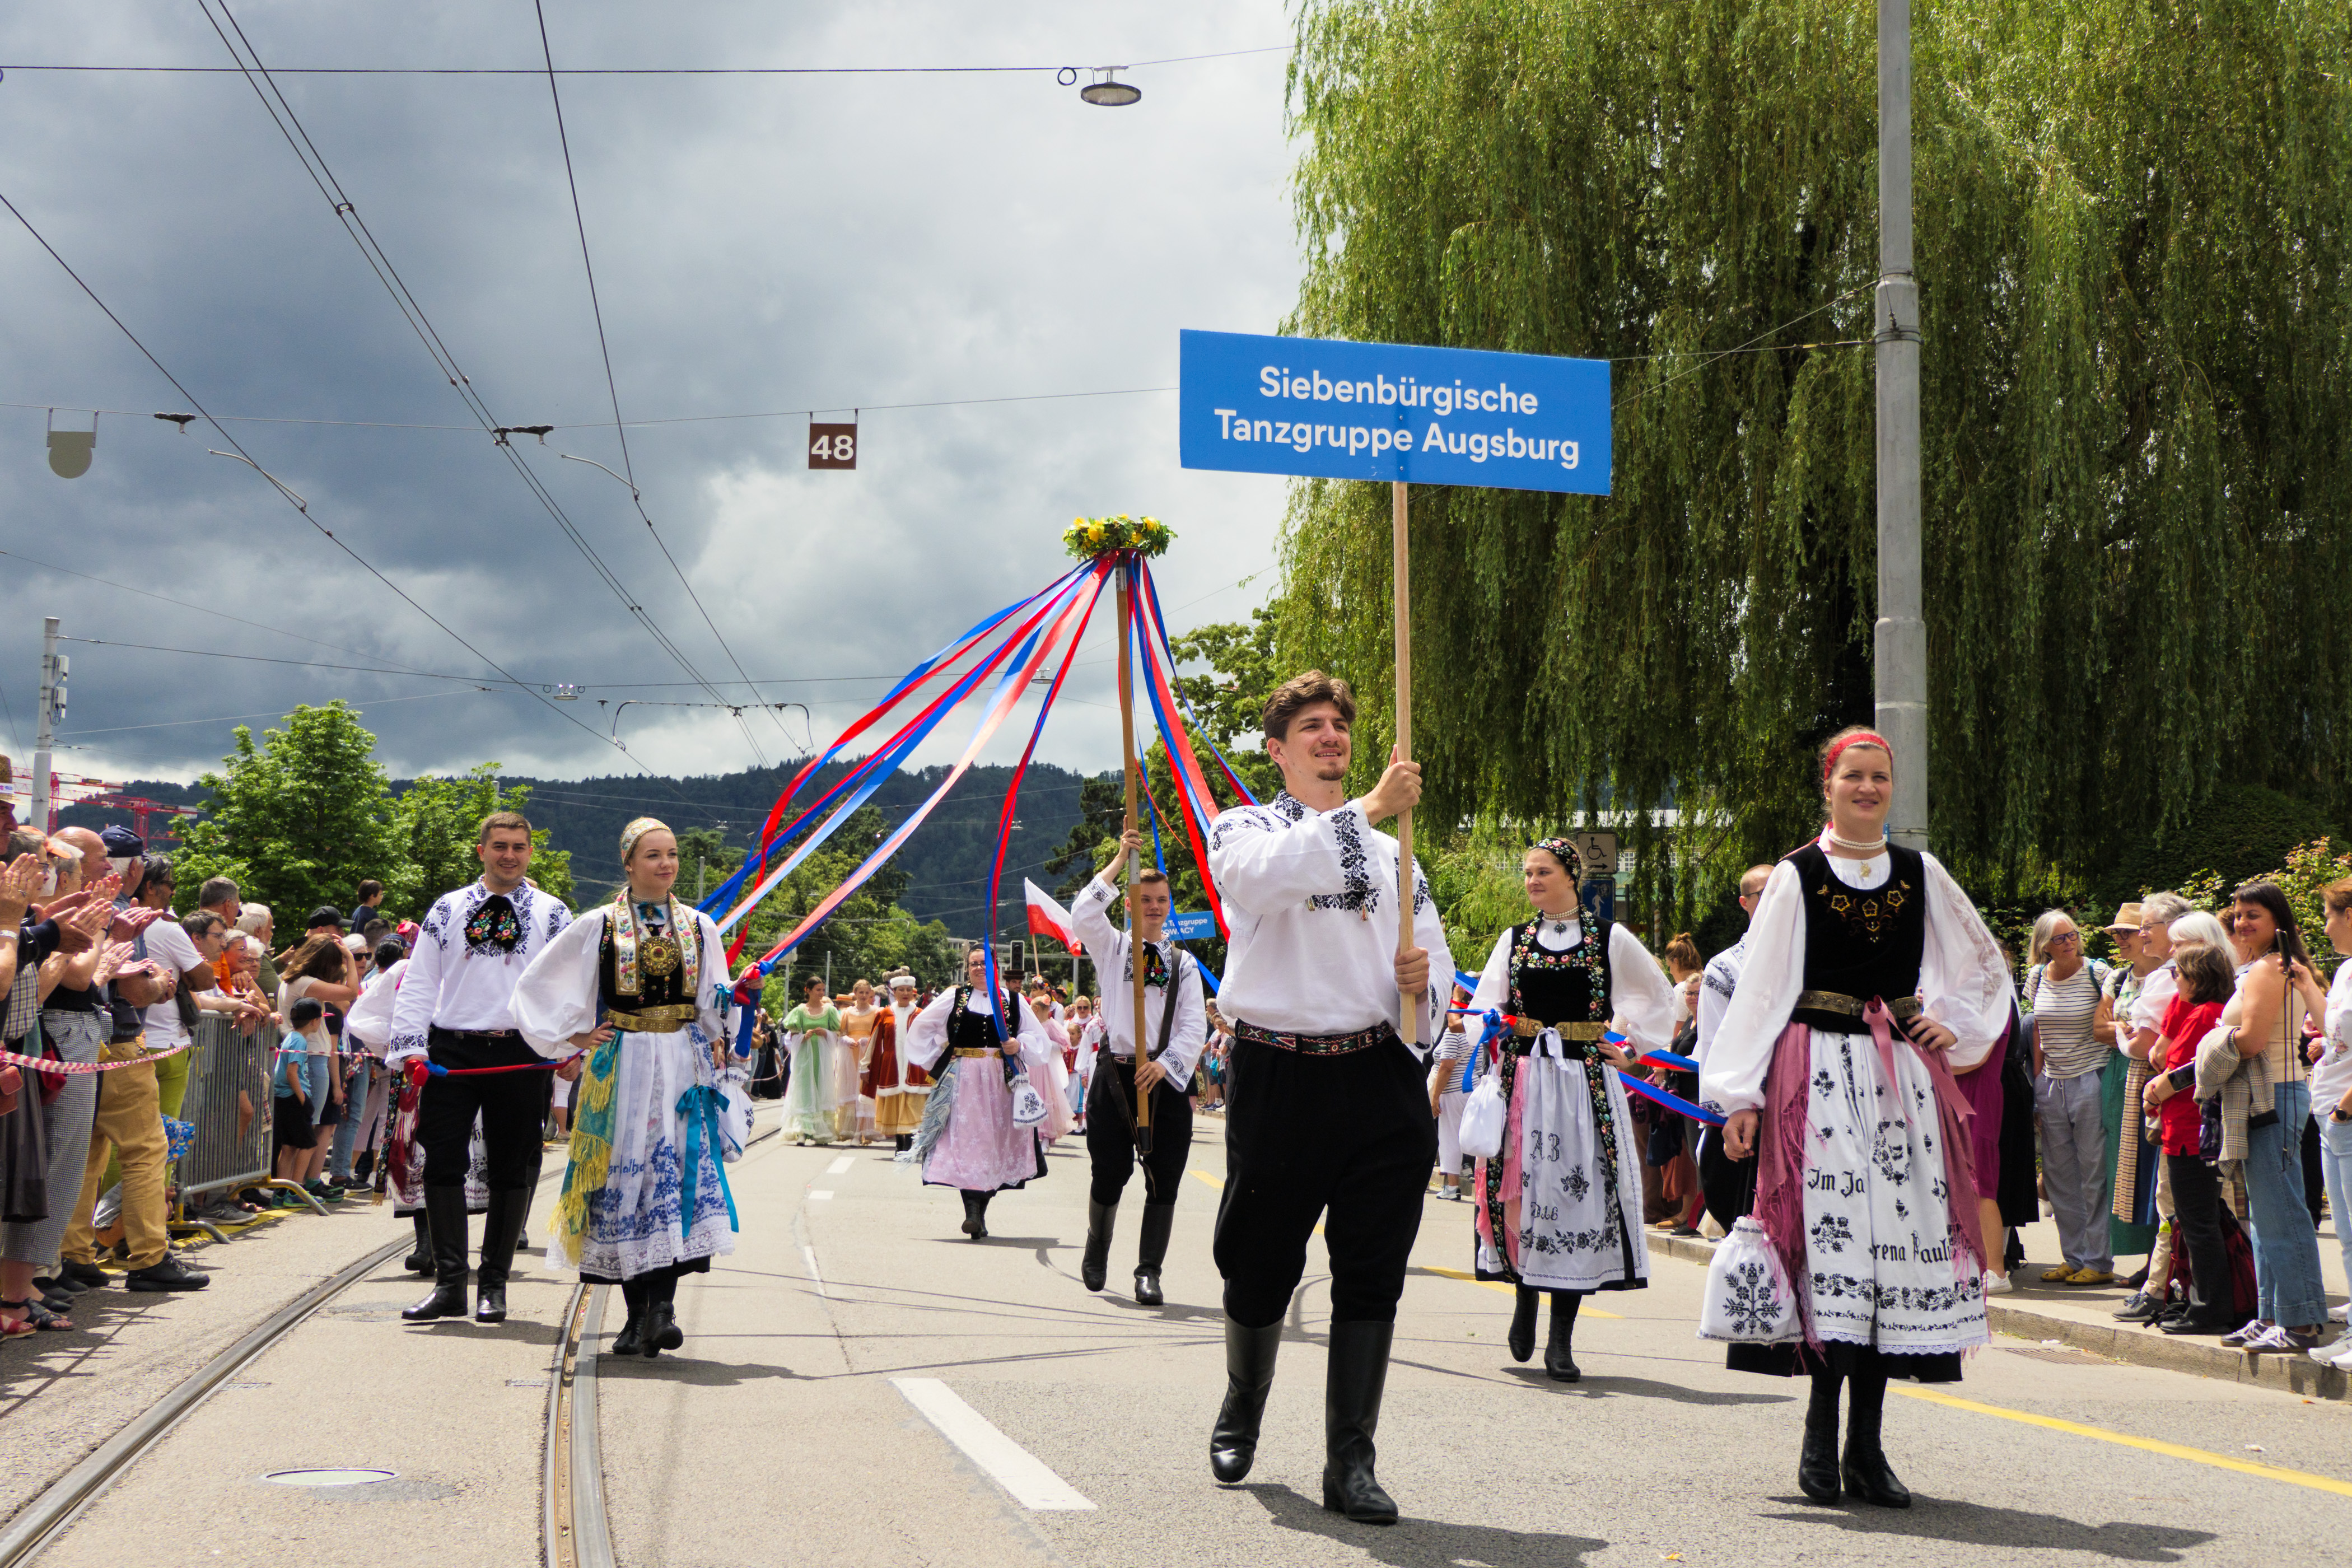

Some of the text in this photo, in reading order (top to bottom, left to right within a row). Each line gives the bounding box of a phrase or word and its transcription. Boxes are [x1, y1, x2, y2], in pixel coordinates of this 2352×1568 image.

[1259, 366, 1538, 416] Siebenbürgische
[811, 435, 854, 460] 48
[1214, 408, 1579, 469] Tanzgruppe Augsburg
